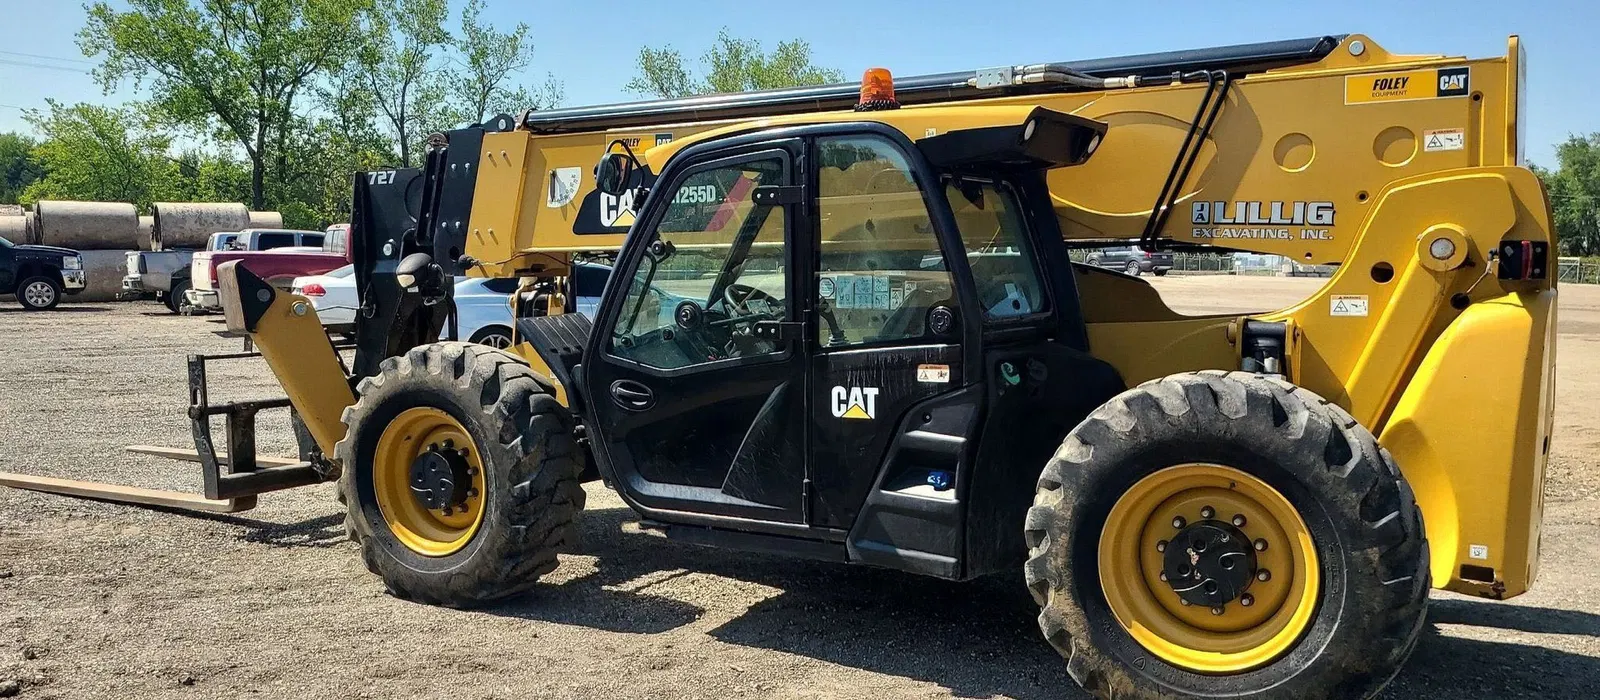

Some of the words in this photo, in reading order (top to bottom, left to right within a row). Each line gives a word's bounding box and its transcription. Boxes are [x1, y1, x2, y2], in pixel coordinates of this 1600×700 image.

[1372, 77, 1409, 91] FOLEY
[1440, 74, 1467, 90] CAT
[1371, 90, 1407, 98] EQUIPMENT
[368, 170, 396, 185] 727
[671, 185, 716, 204] 1255D
[600, 188, 650, 228] CA
[1213, 201, 1336, 226] LILLIG
[1192, 228, 1294, 240] EXCAVATING,
[1300, 229, 1334, 240] INC.
[831, 385, 879, 420] CAT
